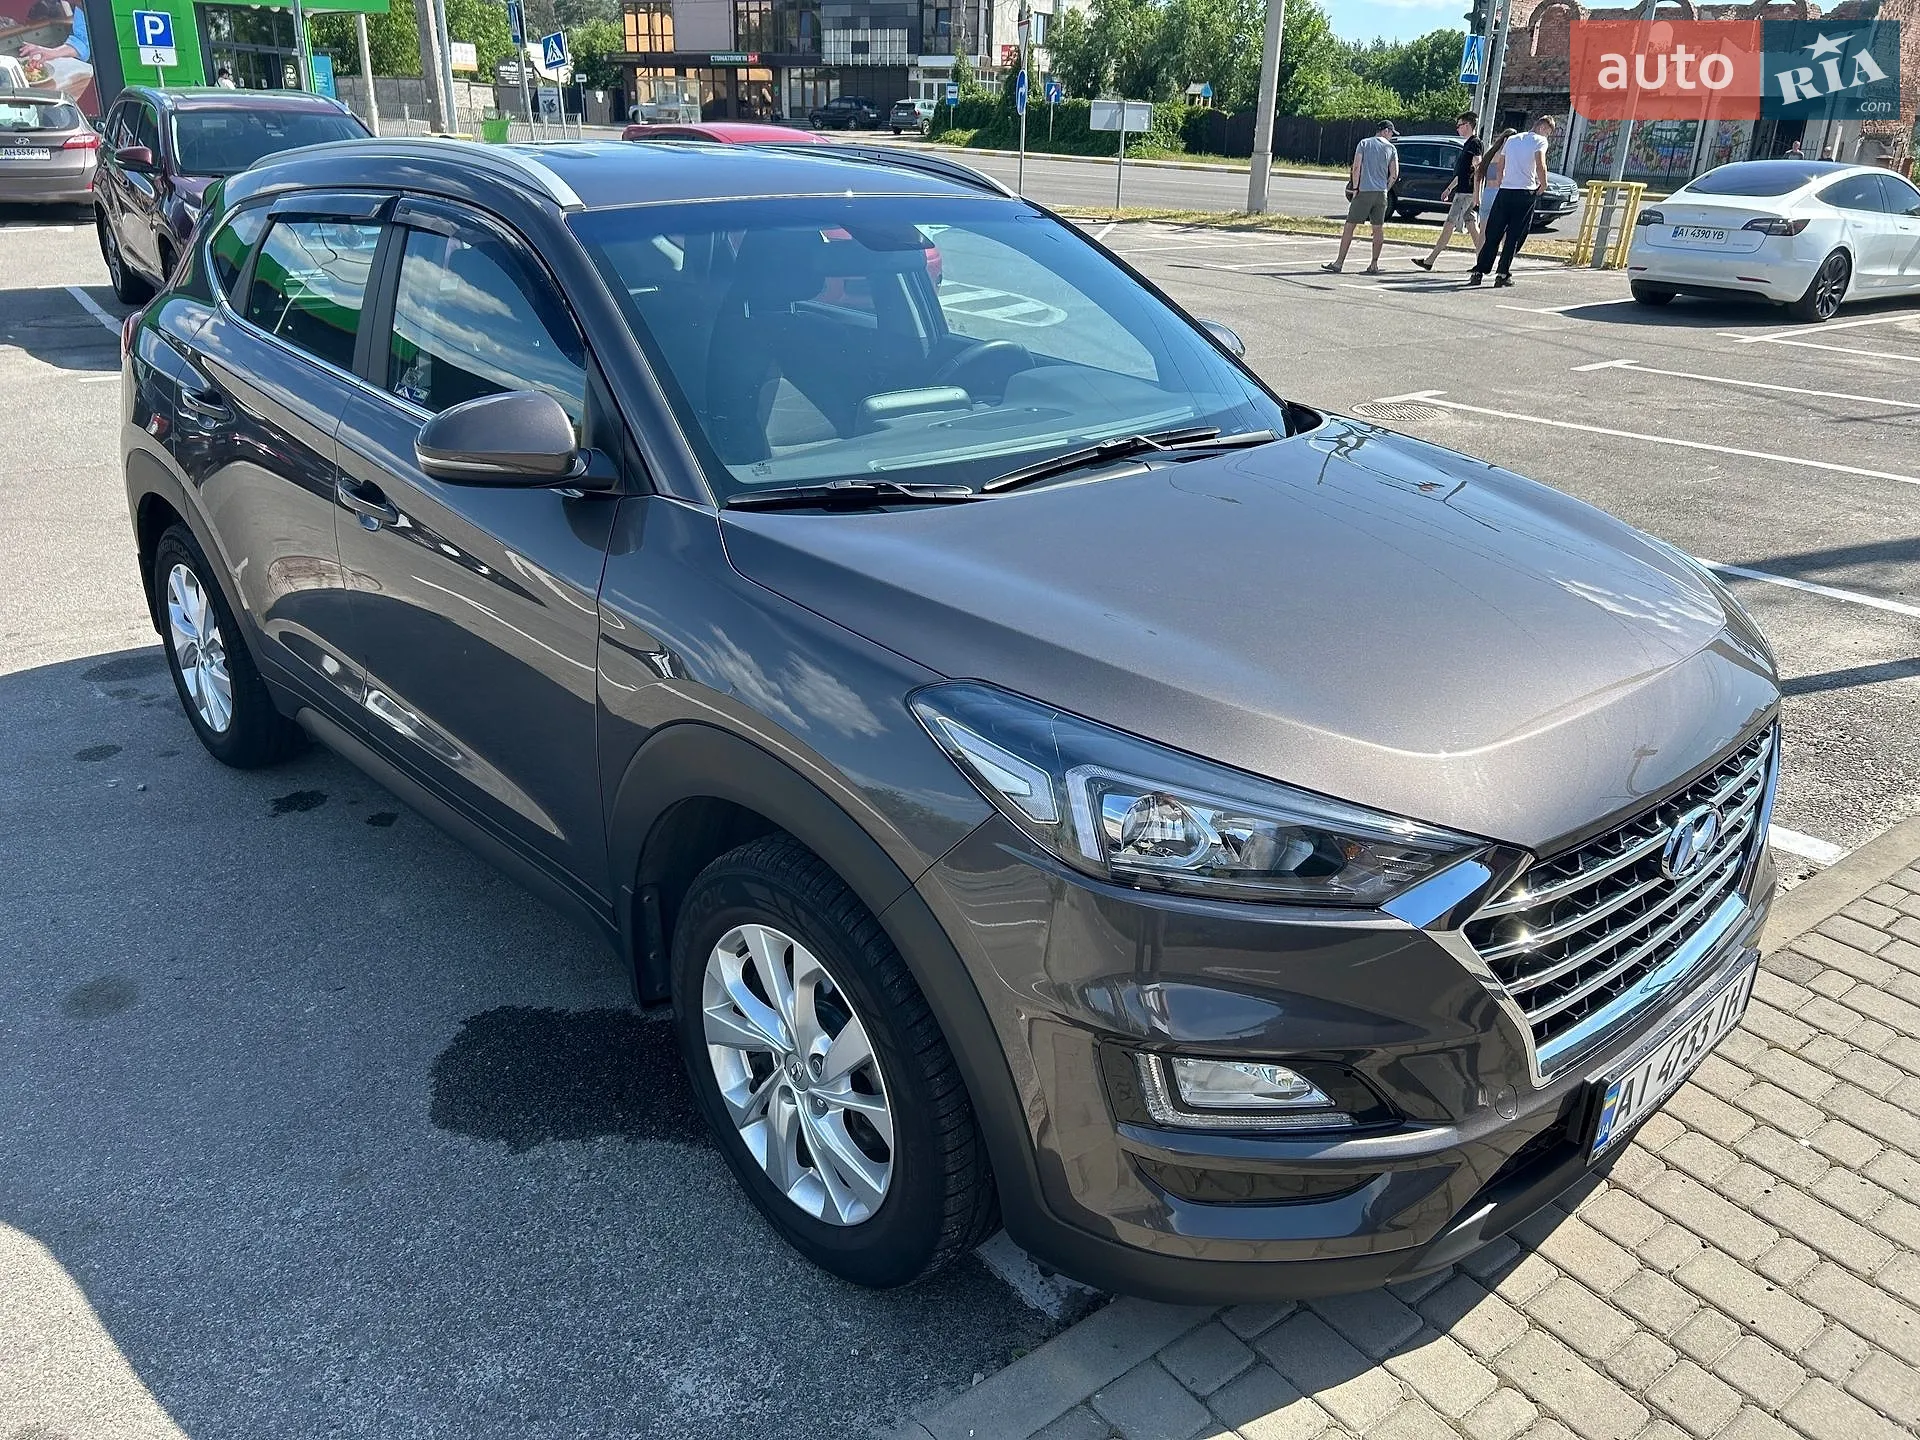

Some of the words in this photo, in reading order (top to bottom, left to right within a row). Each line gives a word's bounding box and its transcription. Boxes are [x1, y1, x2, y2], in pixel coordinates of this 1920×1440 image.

[143, 15, 164, 45] P
[1677, 228, 1689, 238] AI
[1691, 229, 1712, 240] 4390
[1712, 231, 1725, 240] YB
[1610, 1062, 1653, 1130] AI
[1656, 1006, 1716, 1086] 4733
[1714, 976, 1747, 1037] IH
